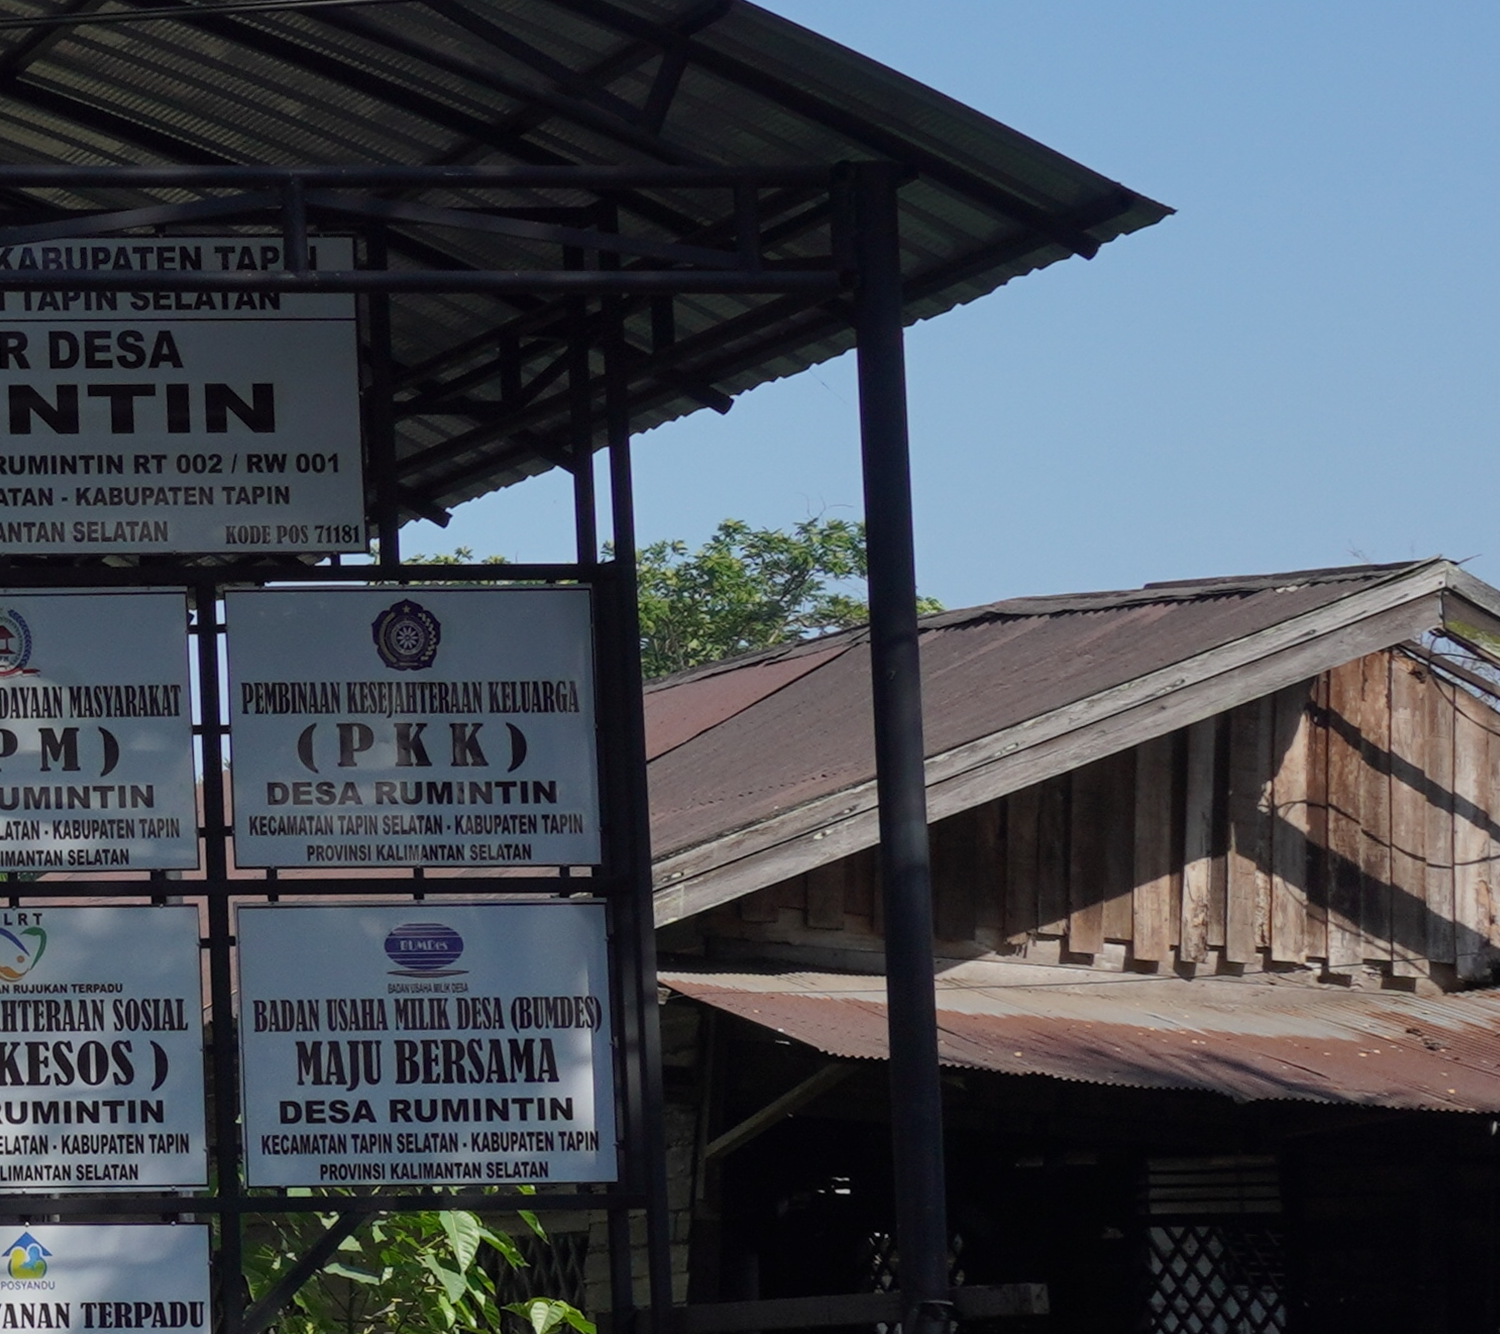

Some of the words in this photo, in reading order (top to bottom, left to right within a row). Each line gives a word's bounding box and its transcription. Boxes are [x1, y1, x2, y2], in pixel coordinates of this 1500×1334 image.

[215, 247, 316, 271] TAP
[131, 290, 281, 311] SELATAN
[49, 330, 182, 369] DESA
[135, 454, 167, 474] RT
[176, 453, 222, 473] 002
[247, 452, 287, 473] RW
[295, 452, 339, 473] 001
[75, 487, 214, 506] KABUPATEN
[221, 486, 290, 505] TAPIN
[72, 521, 169, 544] SELATAN
[226, 525, 270, 544] KODE
[276, 525, 308, 544] POS
[314, 524, 360, 544] 71181
[69, 685, 181, 718] MASYARAKAT
[242, 682, 340, 714] PEMBINAAN
[347, 682, 482, 718] KESEJAHTERAAN
[488, 681, 580, 714] KELUARGA
[267, 782, 363, 805] DESA
[375, 781, 557, 804] RUMINTIN
[13, 984, 67, 994] RUJUKAN
[71, 983, 123, 993] TERPADU
[113, 999, 188, 1032] SOSIAL
[254, 999, 320, 1033] BADAN
[326, 999, 388, 1031] USAHA
[395, 998, 451, 1031] MILIK
[458, 998, 504, 1030] DESA
[510, 996, 602, 1034] (BUMDES)
[296, 1040, 382, 1091] MAJU
[395, 1038, 559, 1084] BERSAMA
[280, 1100, 377, 1124] DESA
[389, 1098, 573, 1123] RUMINTIN
[321, 1164, 385, 1180] PROVINSI
[390, 1163, 481, 1179] KALIMANTAN
[486, 1162, 548, 1178] SELATAN
[0, 1281, 55, 1290] POSYANDU
[81, 1301, 204, 1329] TERPADU
